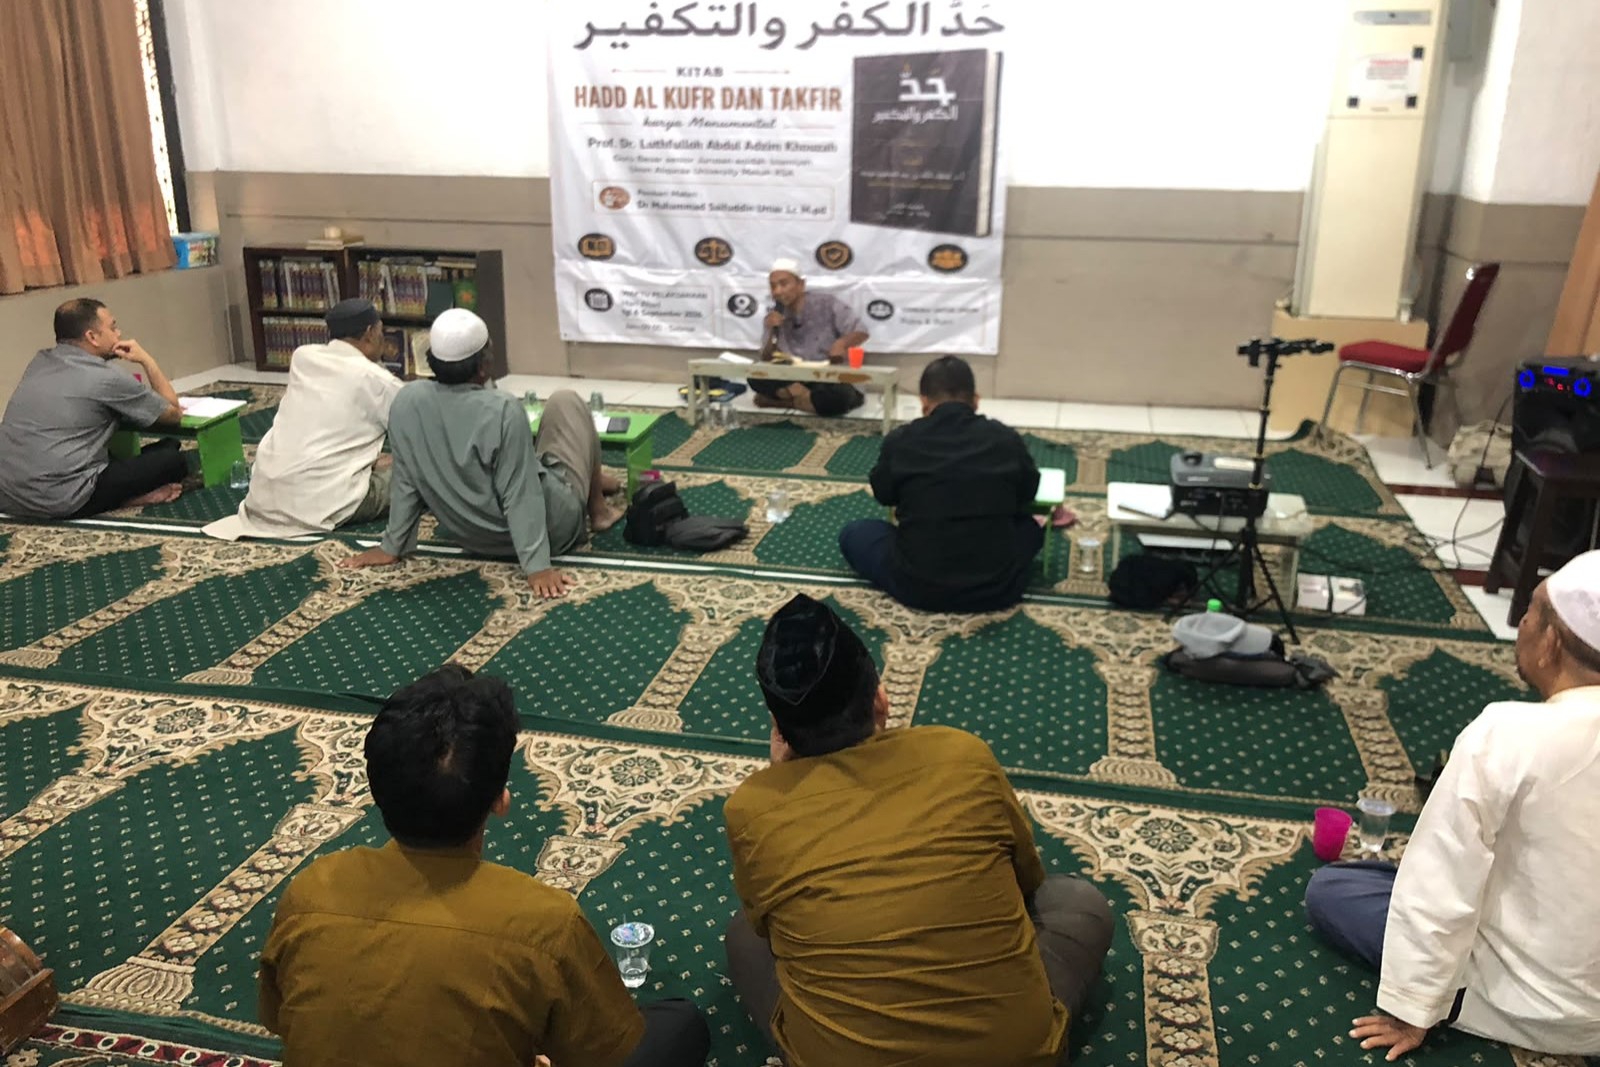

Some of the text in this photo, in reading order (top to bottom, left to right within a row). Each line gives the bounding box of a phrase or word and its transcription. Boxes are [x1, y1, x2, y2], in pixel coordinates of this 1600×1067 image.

[573, 2, 787, 50] والتكفير
[795, 1, 930, 50] الكفر
[676, 67, 724, 78] KITAB
[574, 85, 843, 112] HADD AL KUFR DAN TAKFIR
